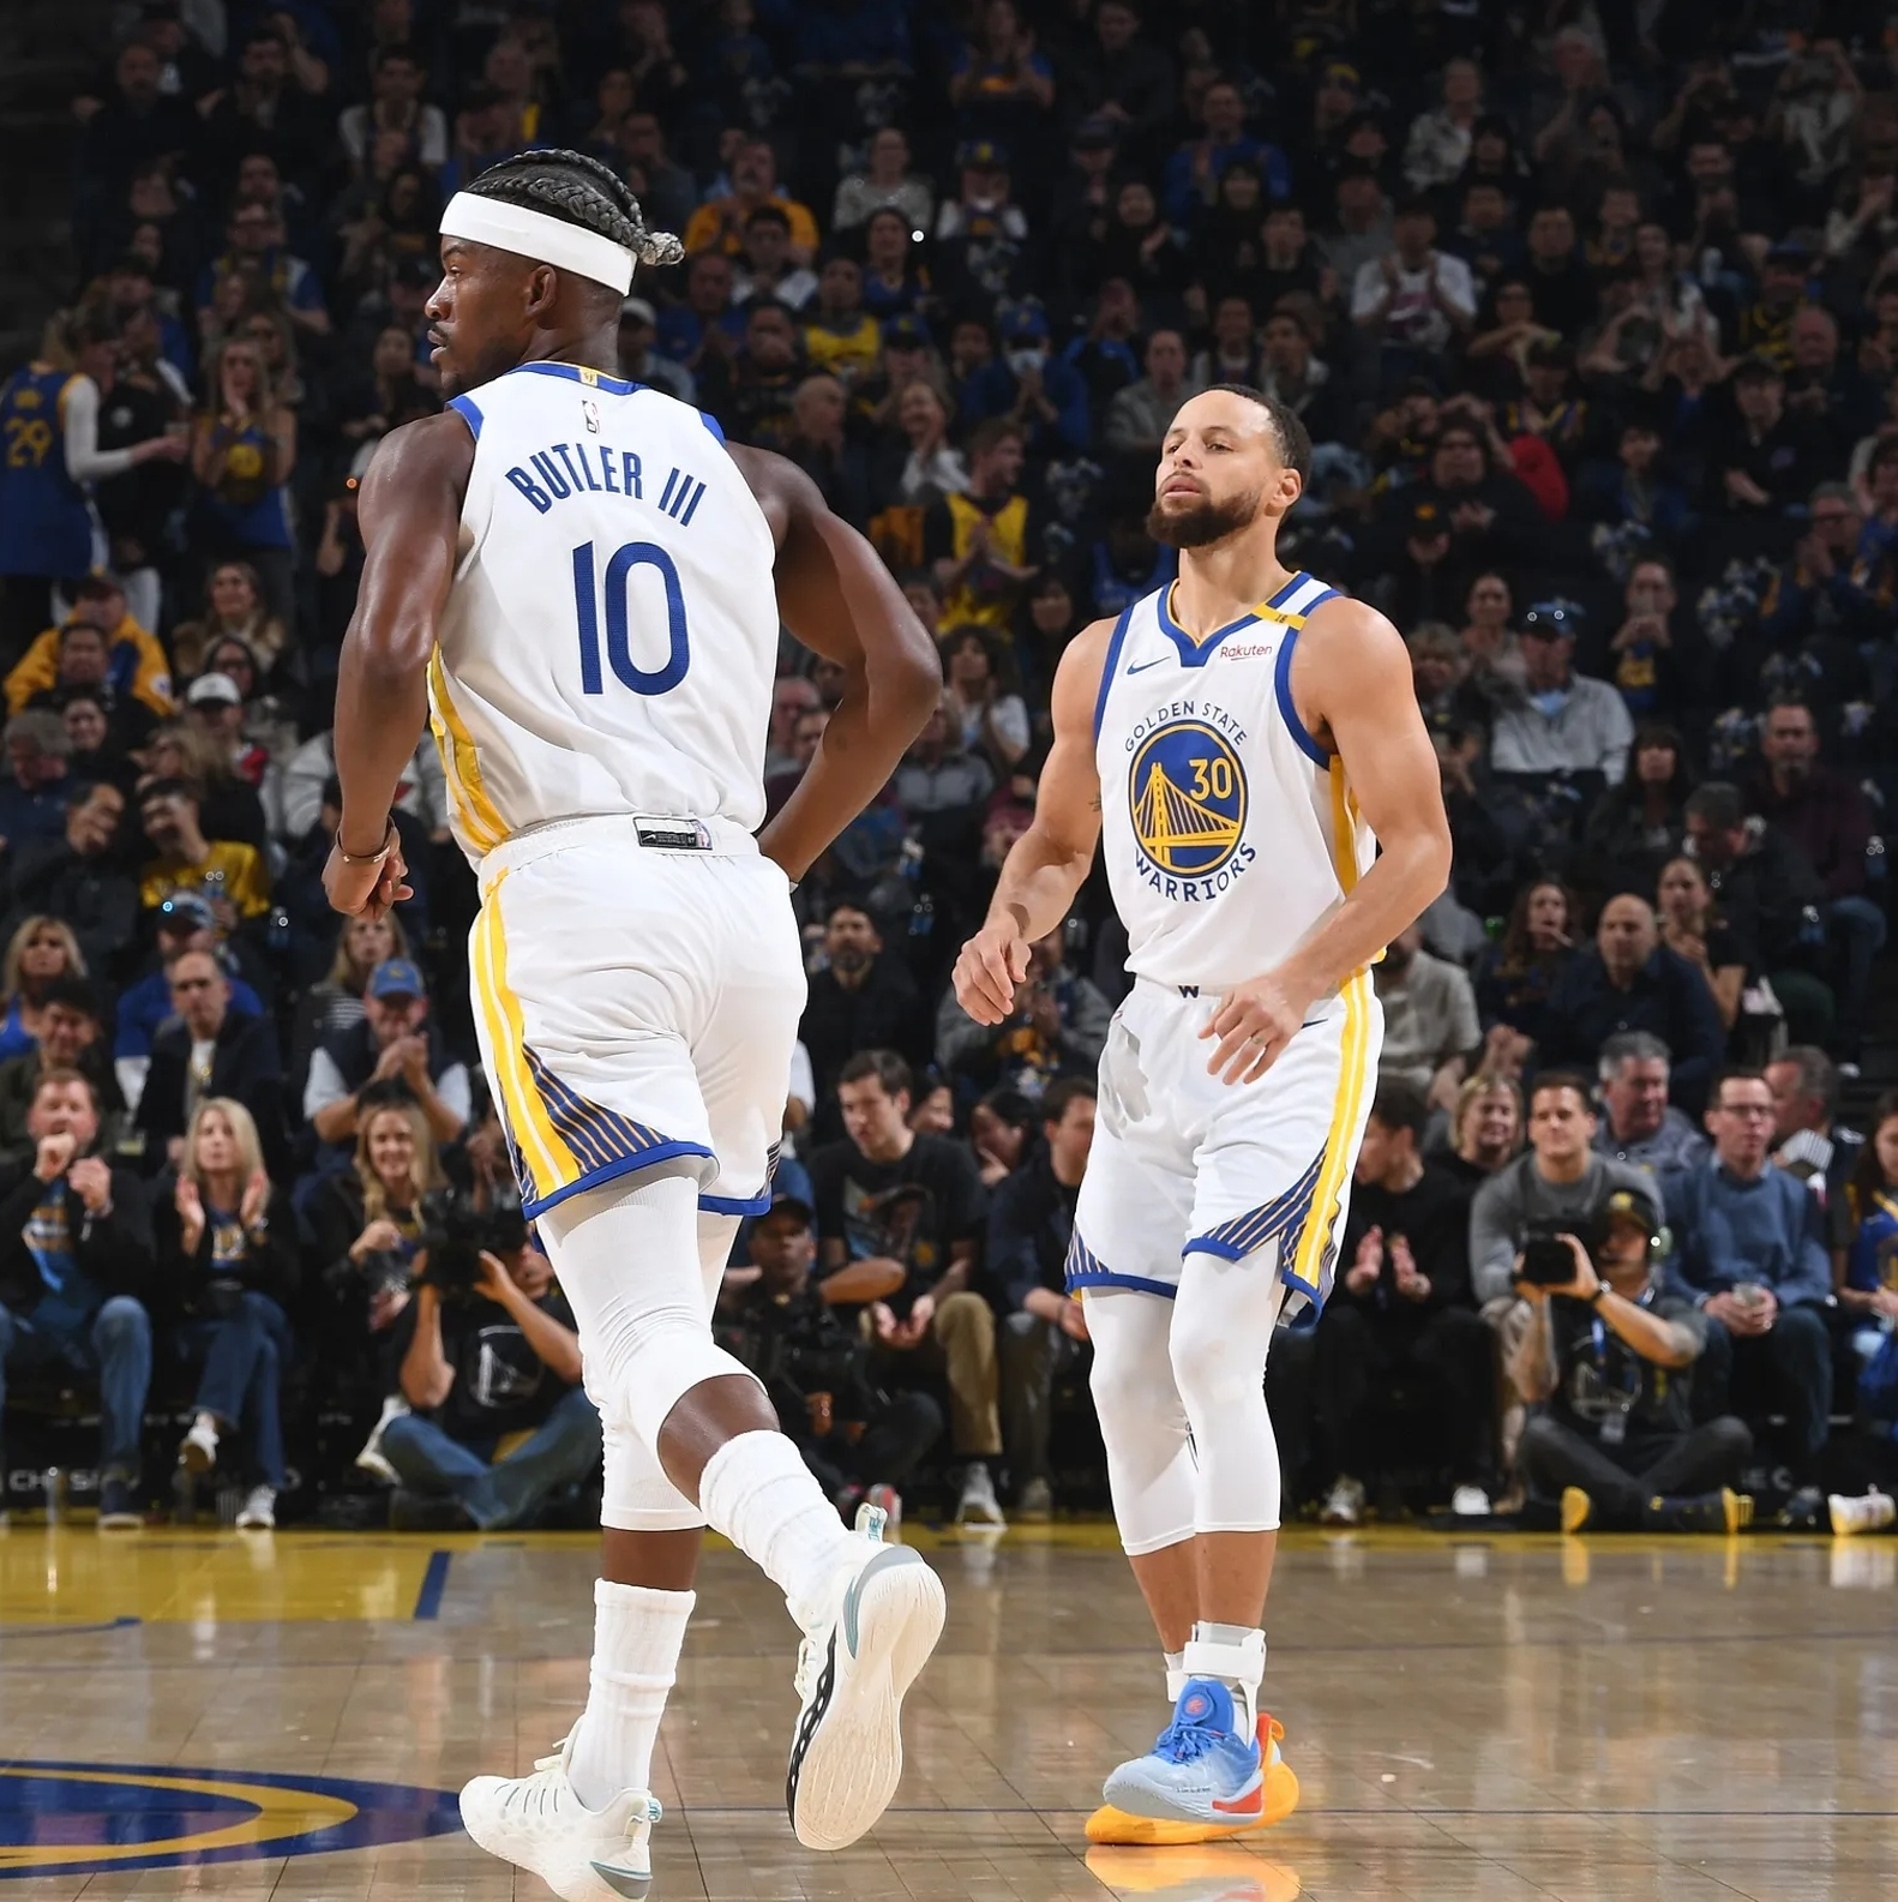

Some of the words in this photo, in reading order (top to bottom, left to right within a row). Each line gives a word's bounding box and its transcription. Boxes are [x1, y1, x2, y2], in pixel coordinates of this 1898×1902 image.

[505, 443, 643, 514] BUTLER
[658, 467, 707, 527] III
[572, 540, 690, 696] 10
[1220, 644, 1273, 659] Rakuten
[1124, 700, 1195, 752] GOLDEN
[1202, 702, 1247, 746] STATE
[1189, 757, 1232, 800] 30
[1135, 842, 1256, 901] WARRIORS
